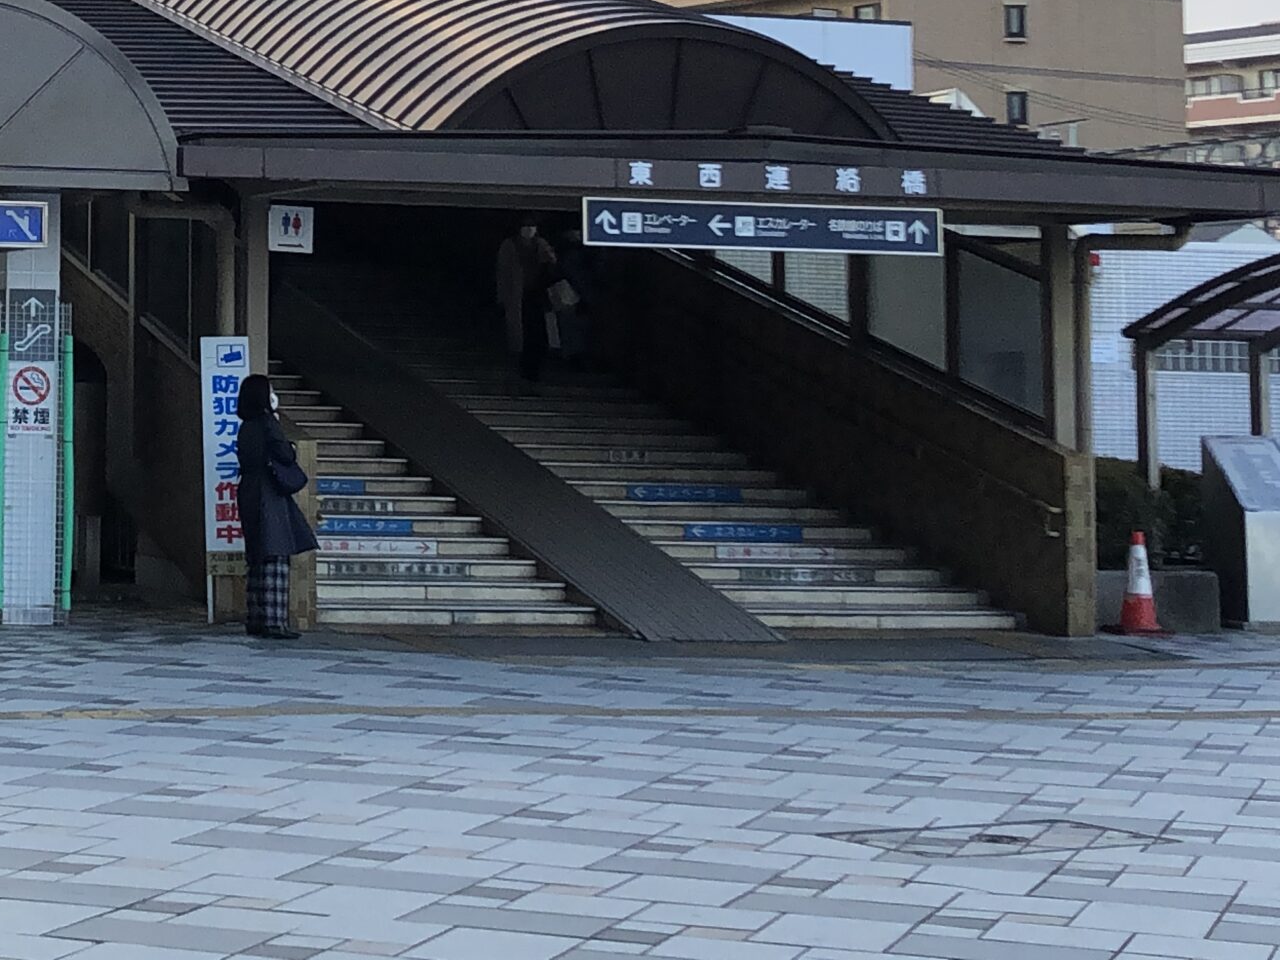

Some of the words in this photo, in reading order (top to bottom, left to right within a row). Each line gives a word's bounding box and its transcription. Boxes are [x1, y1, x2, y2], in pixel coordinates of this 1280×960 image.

[629, 161, 927, 195] 東西連絡橋
[12, 407, 50, 424] 禁煙
